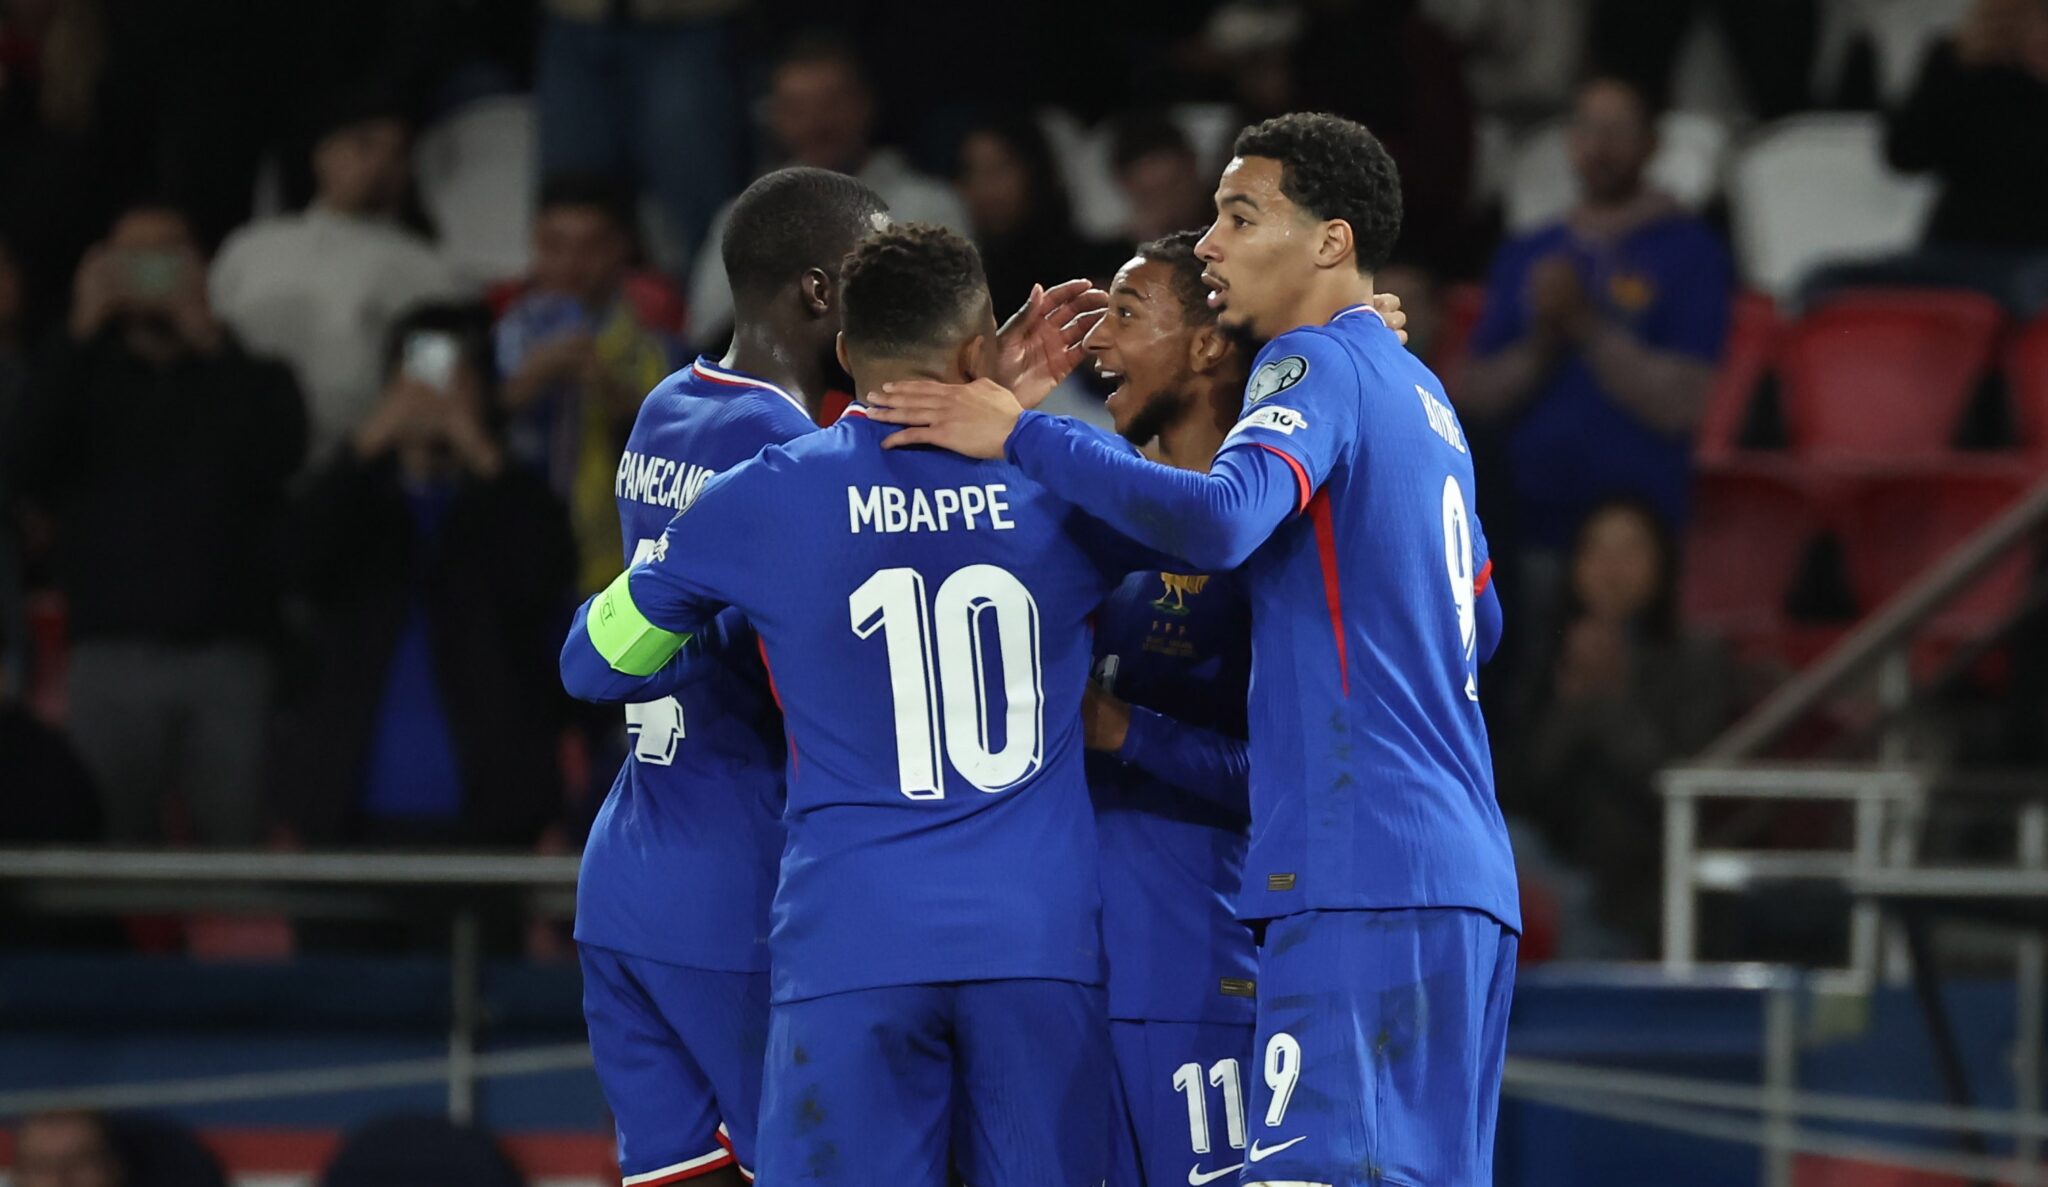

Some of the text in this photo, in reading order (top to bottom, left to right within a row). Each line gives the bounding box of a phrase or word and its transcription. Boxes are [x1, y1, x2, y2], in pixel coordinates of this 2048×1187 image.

[615, 450, 716, 511] PAMECAN
[847, 483, 1015, 534] MBAPPE
[849, 563, 1045, 801] 10
[1172, 1057, 1247, 1154] 11
[1264, 1032, 1301, 1127] 9
